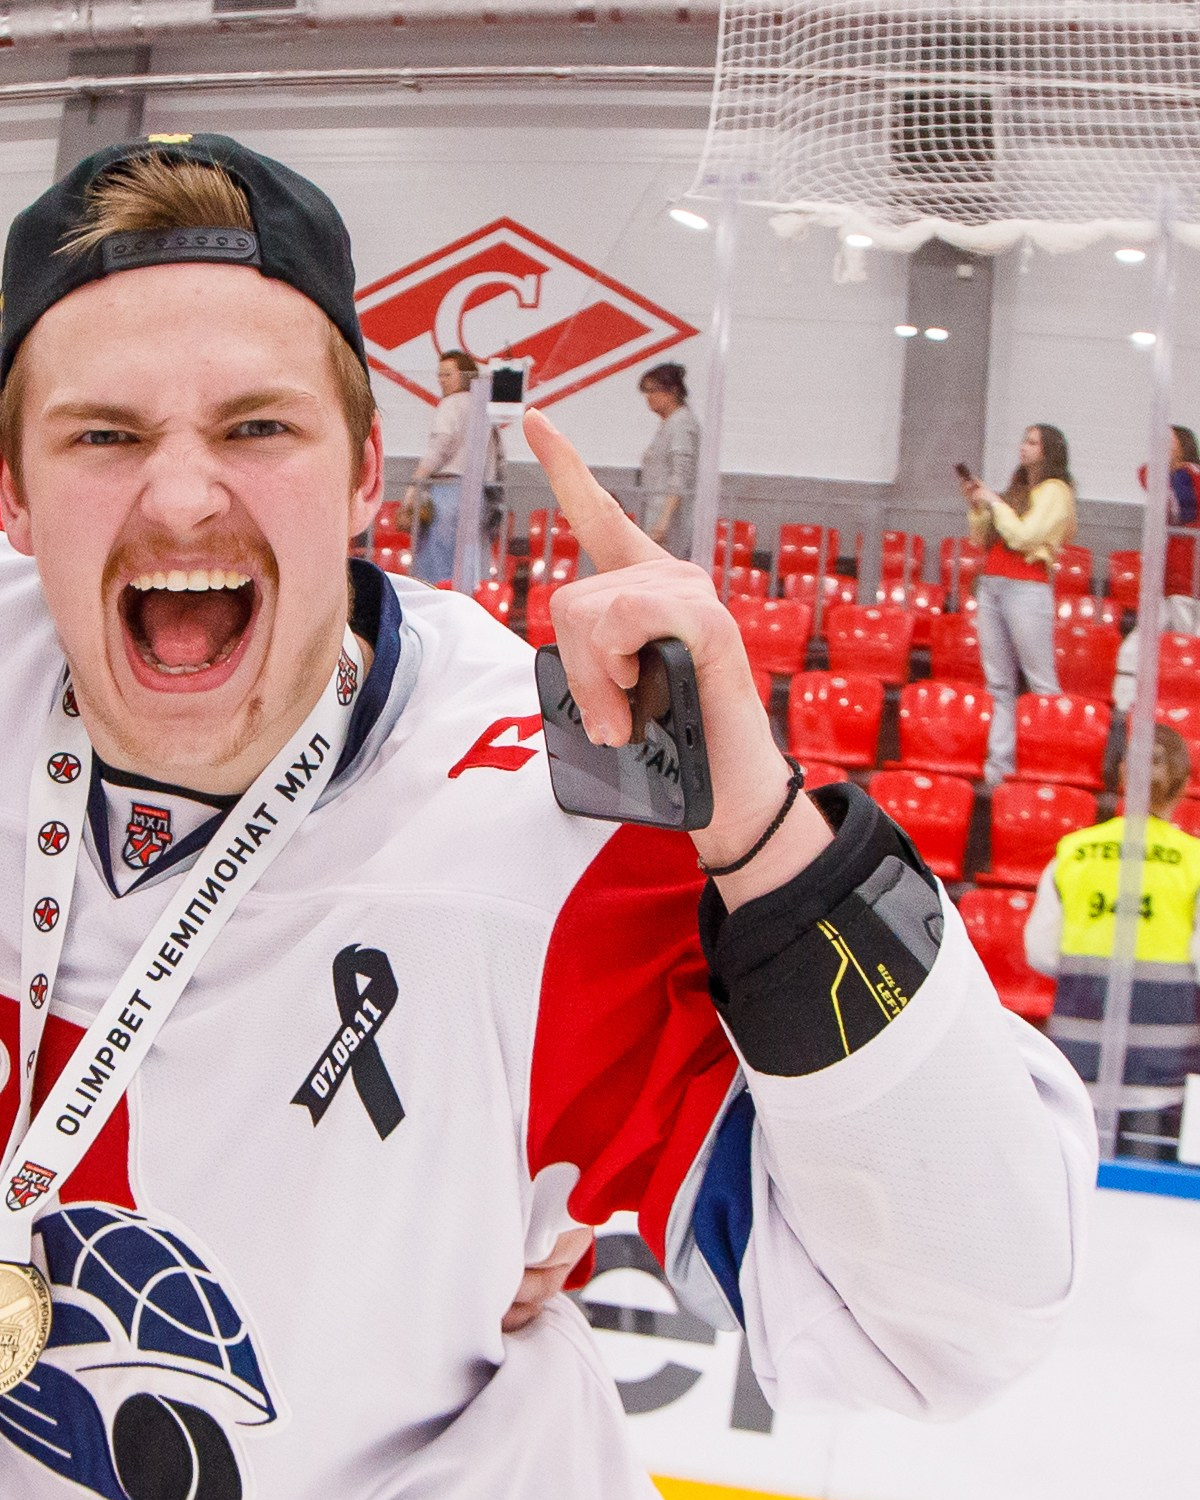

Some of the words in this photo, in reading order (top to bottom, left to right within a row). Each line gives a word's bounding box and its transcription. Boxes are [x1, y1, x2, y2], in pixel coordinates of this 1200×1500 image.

[133, 813, 169, 832] МХЛ
[1074, 841, 1182, 865] STERD
[55, 988, 152, 1136] OLIMPBET
[145, 801, 279, 982] ЧЕМПИОНАТ
[274, 732, 331, 802] МХЛ
[876, 982, 901, 1015] LEFT
[310, 998, 382, 1098] 07.09.11
